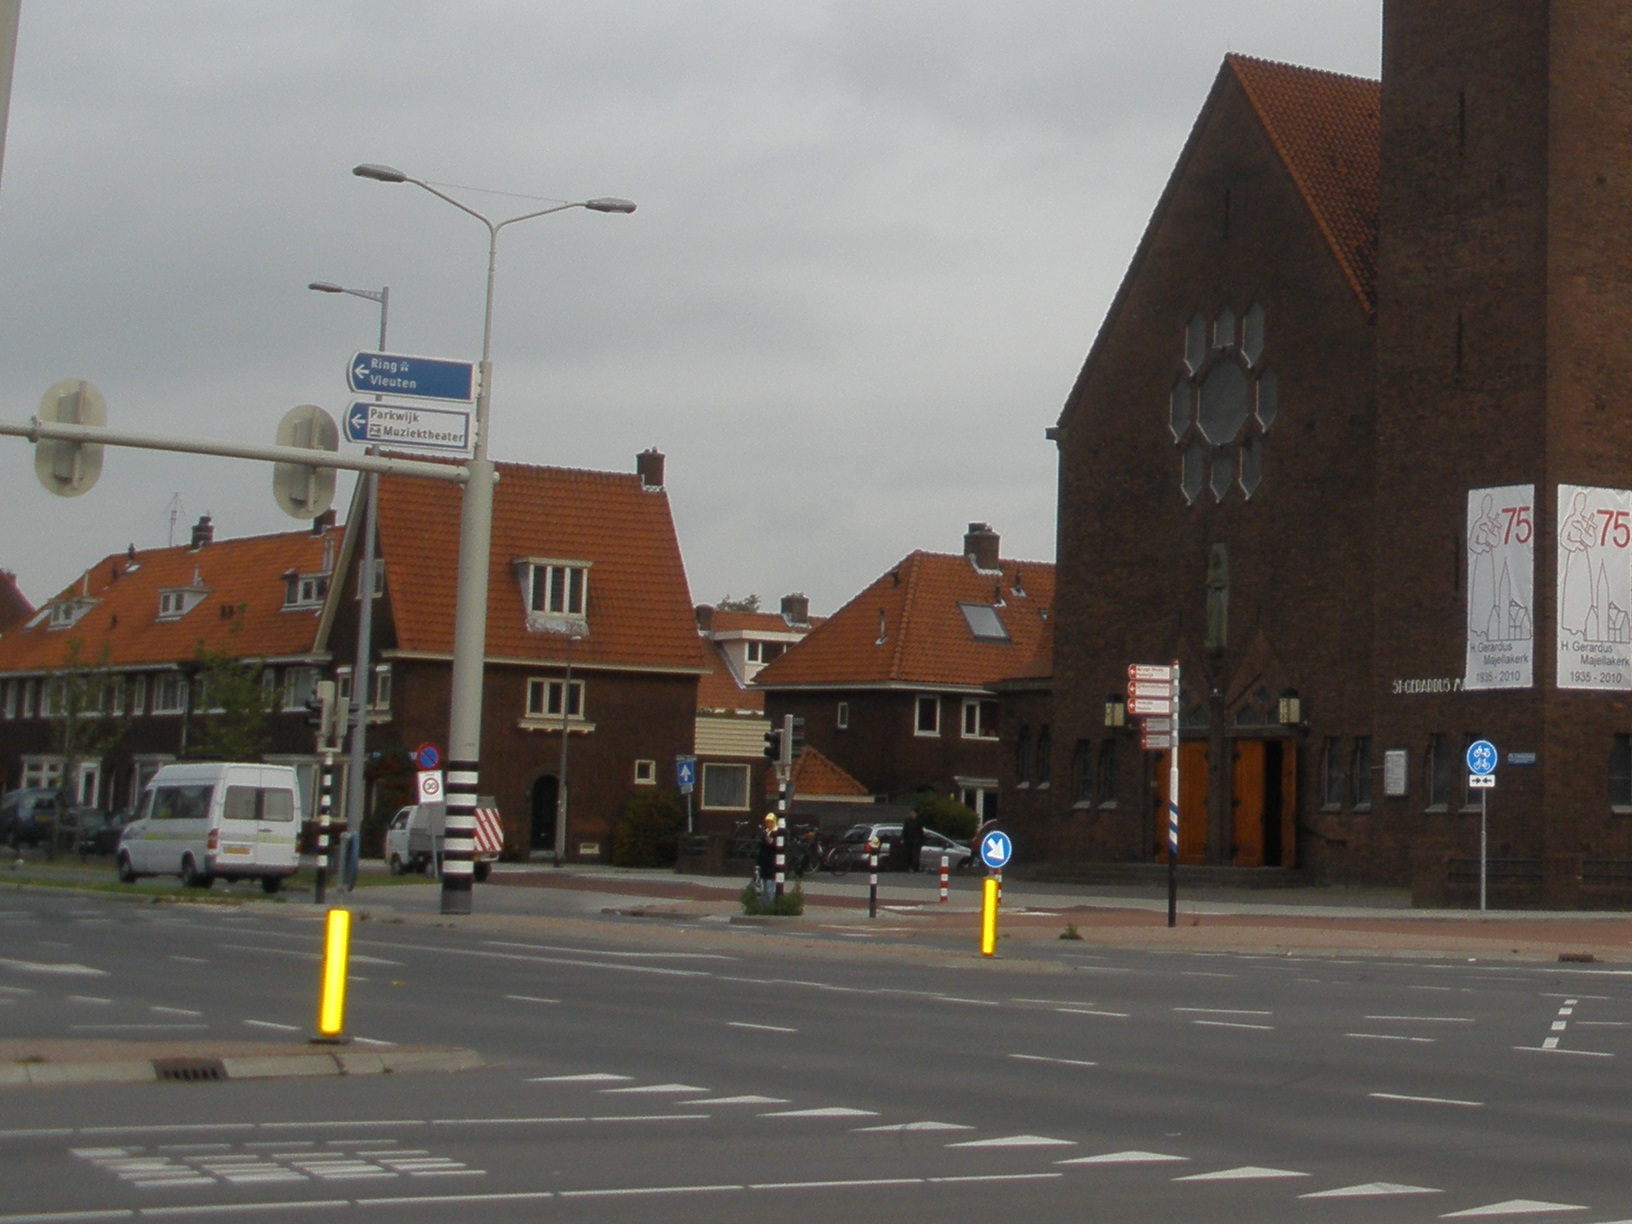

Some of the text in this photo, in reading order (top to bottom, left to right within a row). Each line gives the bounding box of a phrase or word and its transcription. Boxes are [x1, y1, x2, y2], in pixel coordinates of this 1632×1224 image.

[371, 358, 397, 373] Ring
[371, 375, 416, 389] Vleuten
[371, 408, 419, 424] Parkwijk
[384, 425, 464, 442] Muziektheater
[1501, 506, 1532, 545] 75
[1597, 509, 1631, 548] 75
[1478, 642, 1512, 653] Gerardus
[1572, 642, 1613, 653] Gerardus
[1483, 654, 1529, 667] Majellakerk
[1580, 655, 1630, 667] Majellakerk
[1500, 670, 1521, 682] 2010
[1570, 671, 1591, 682] 1935
[1600, 672, 1622, 683] 2010
